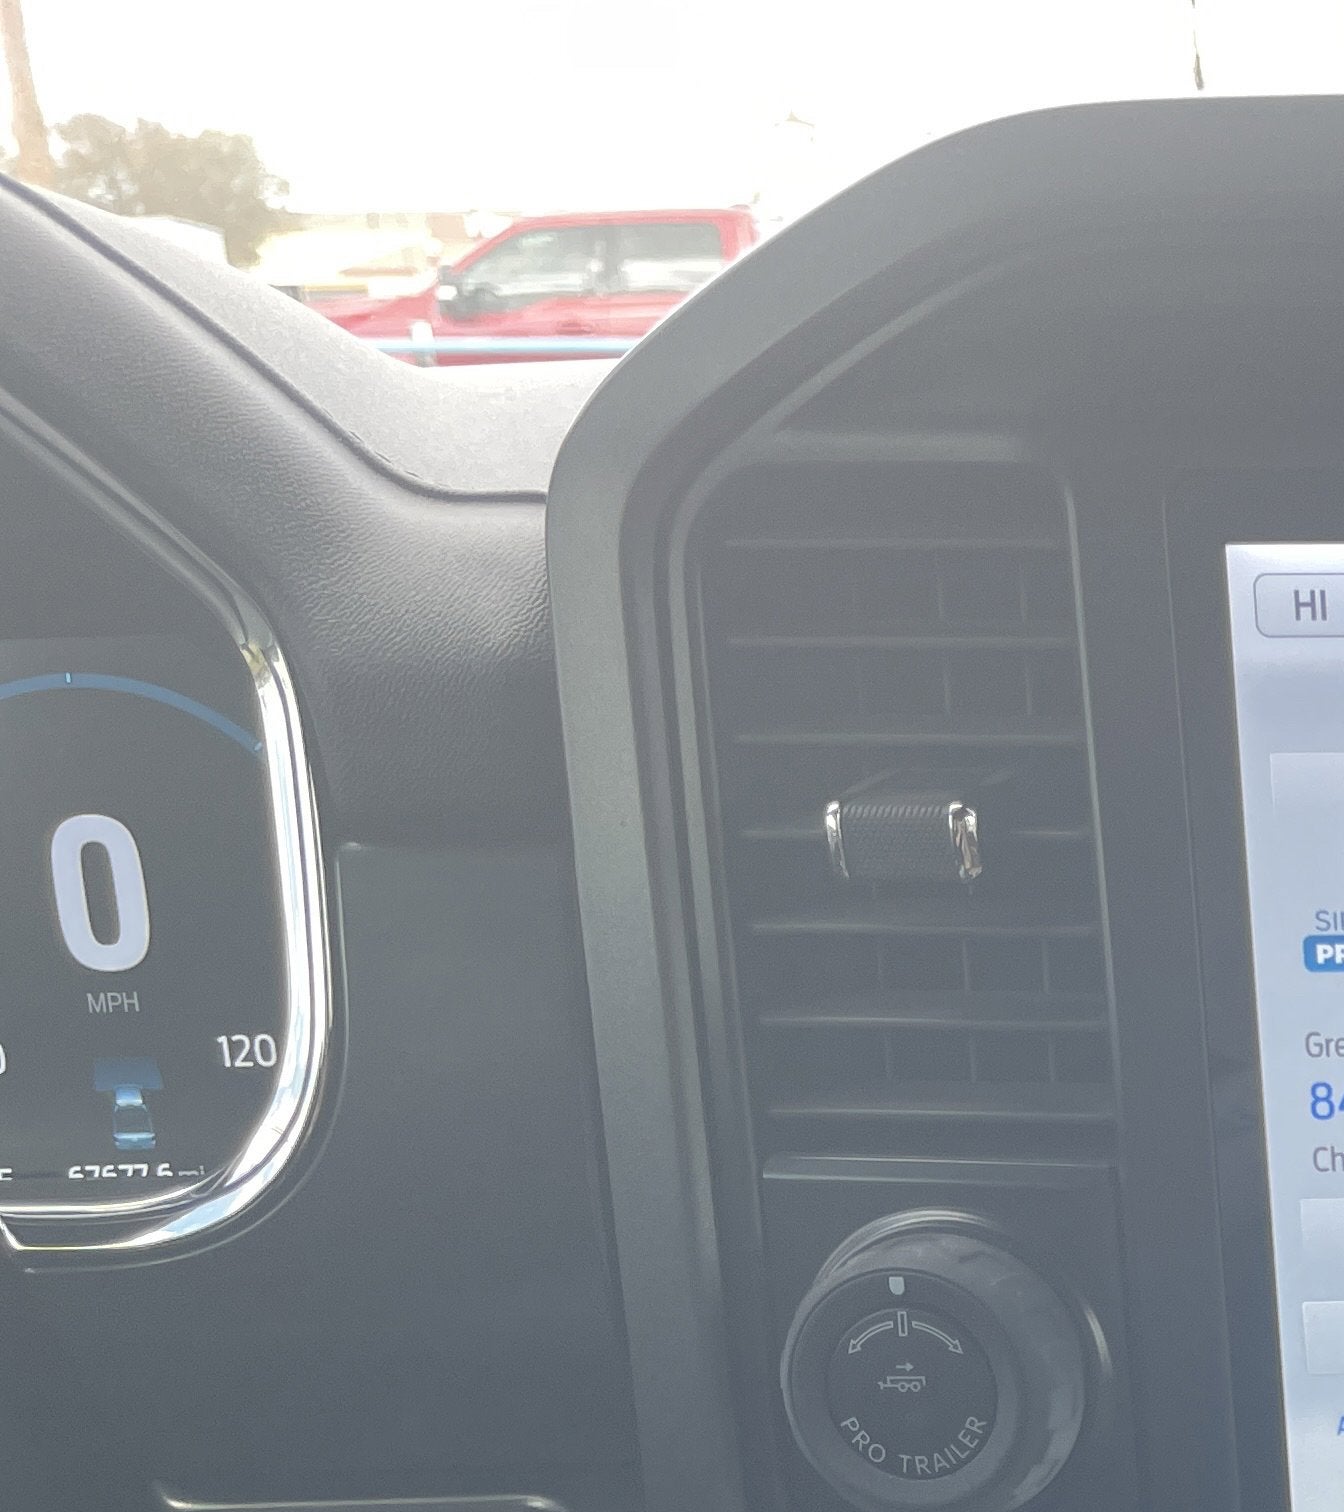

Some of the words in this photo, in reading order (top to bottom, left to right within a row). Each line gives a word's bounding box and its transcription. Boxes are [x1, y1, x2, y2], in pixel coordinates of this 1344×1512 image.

[1293, 589, 1329, 622] HI
[50, 813, 151, 973] 0
[87, 991, 141, 1016] MPH
[216, 1034, 278, 1069] 120
[840, 1416, 887, 1464] PRO
[899, 1415, 988, 1475] TRAILER
